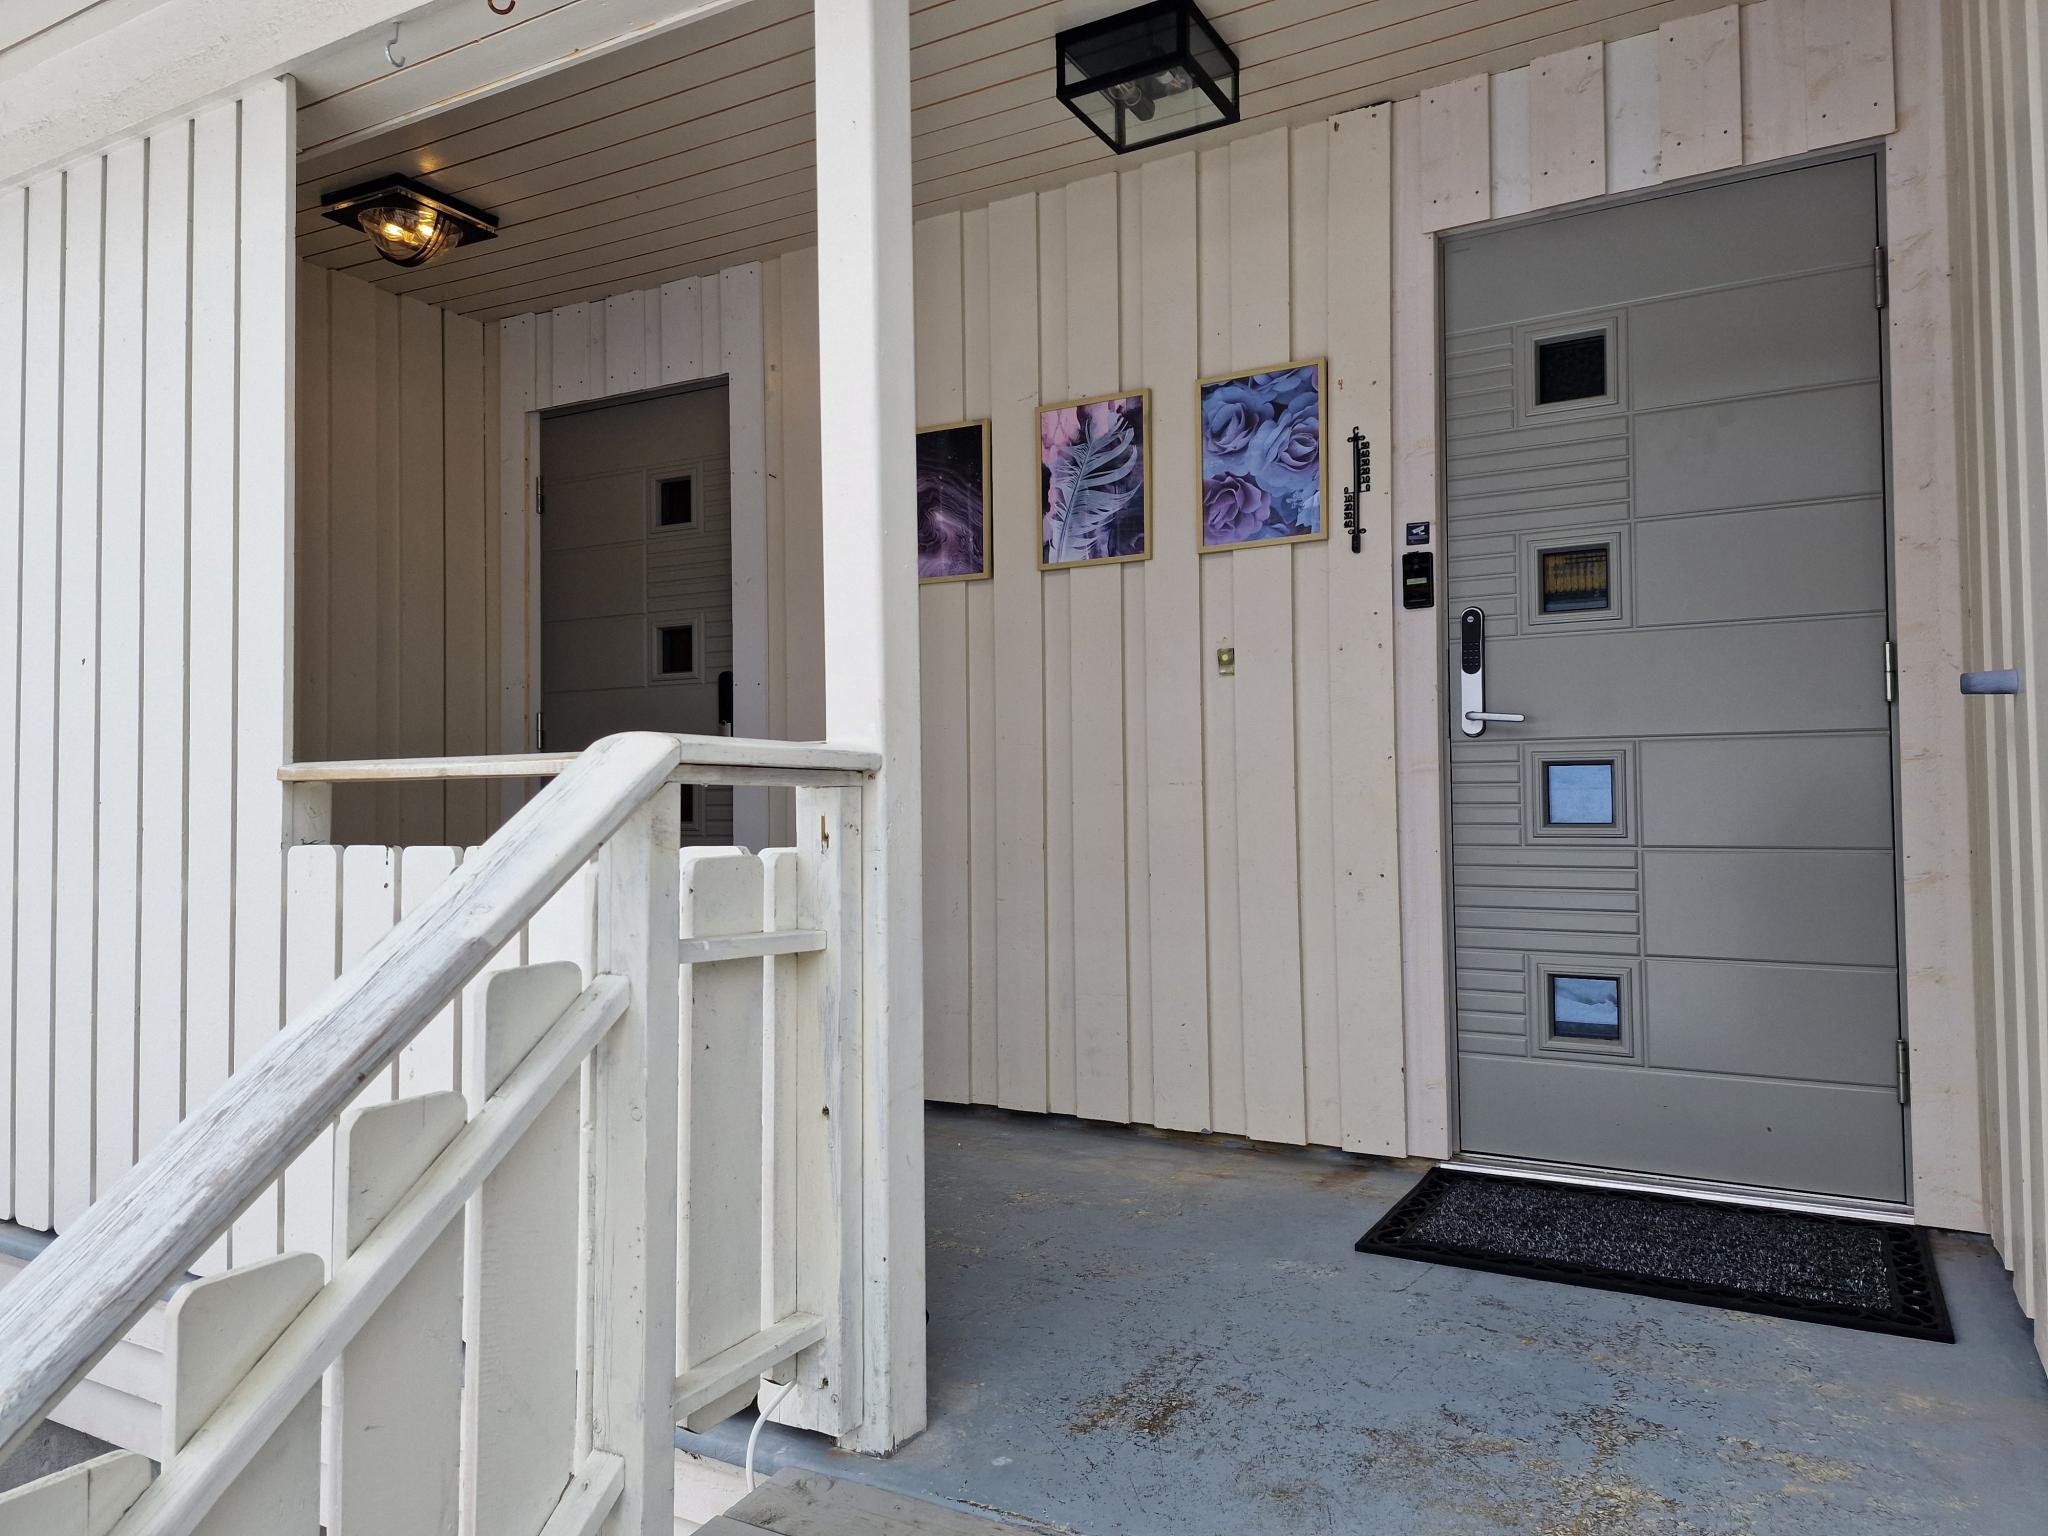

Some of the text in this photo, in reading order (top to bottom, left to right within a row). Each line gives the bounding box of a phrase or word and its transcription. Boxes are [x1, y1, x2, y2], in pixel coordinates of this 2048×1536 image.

[1361, 475, 1370, 483] 10
[1344, 495, 1353, 503] 10
[1344, 503, 1353, 511] 20
